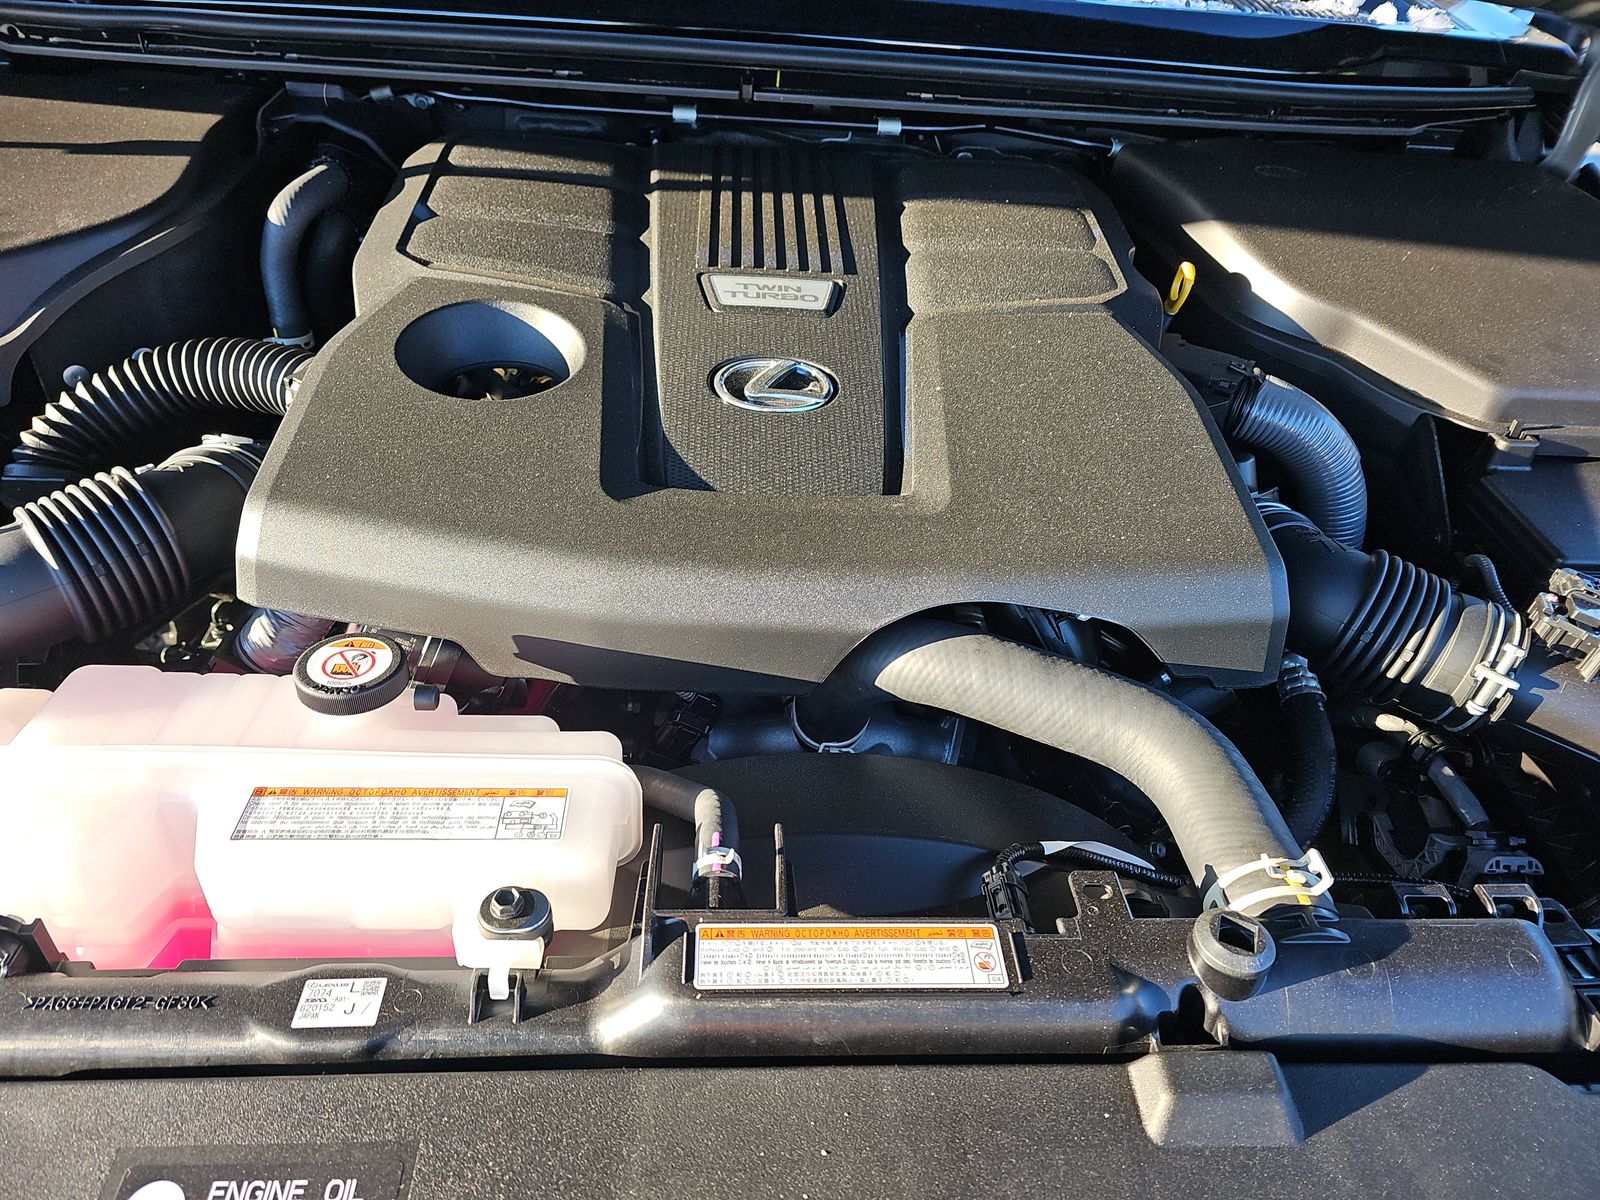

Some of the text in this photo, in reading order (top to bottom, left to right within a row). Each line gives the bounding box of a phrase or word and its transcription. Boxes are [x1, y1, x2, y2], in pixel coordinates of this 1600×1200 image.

[735, 282, 801, 293] TWIN
[723, 290, 819, 303] TURBO
[303, 788, 343, 796] WARNING
[412, 788, 480, 797] AVERTISSEMENT
[751, 928, 790, 938] WARNING
[854, 928, 921, 938] AVERTISSEMENT
[349, 981, 360, 993] L
[308, 988, 333, 997] 7074
[343, 1002, 356, 1015] J
[299, 1012, 321, 1020] JAPAN
[206, 1178, 365, 1200] ENGINE OIL
